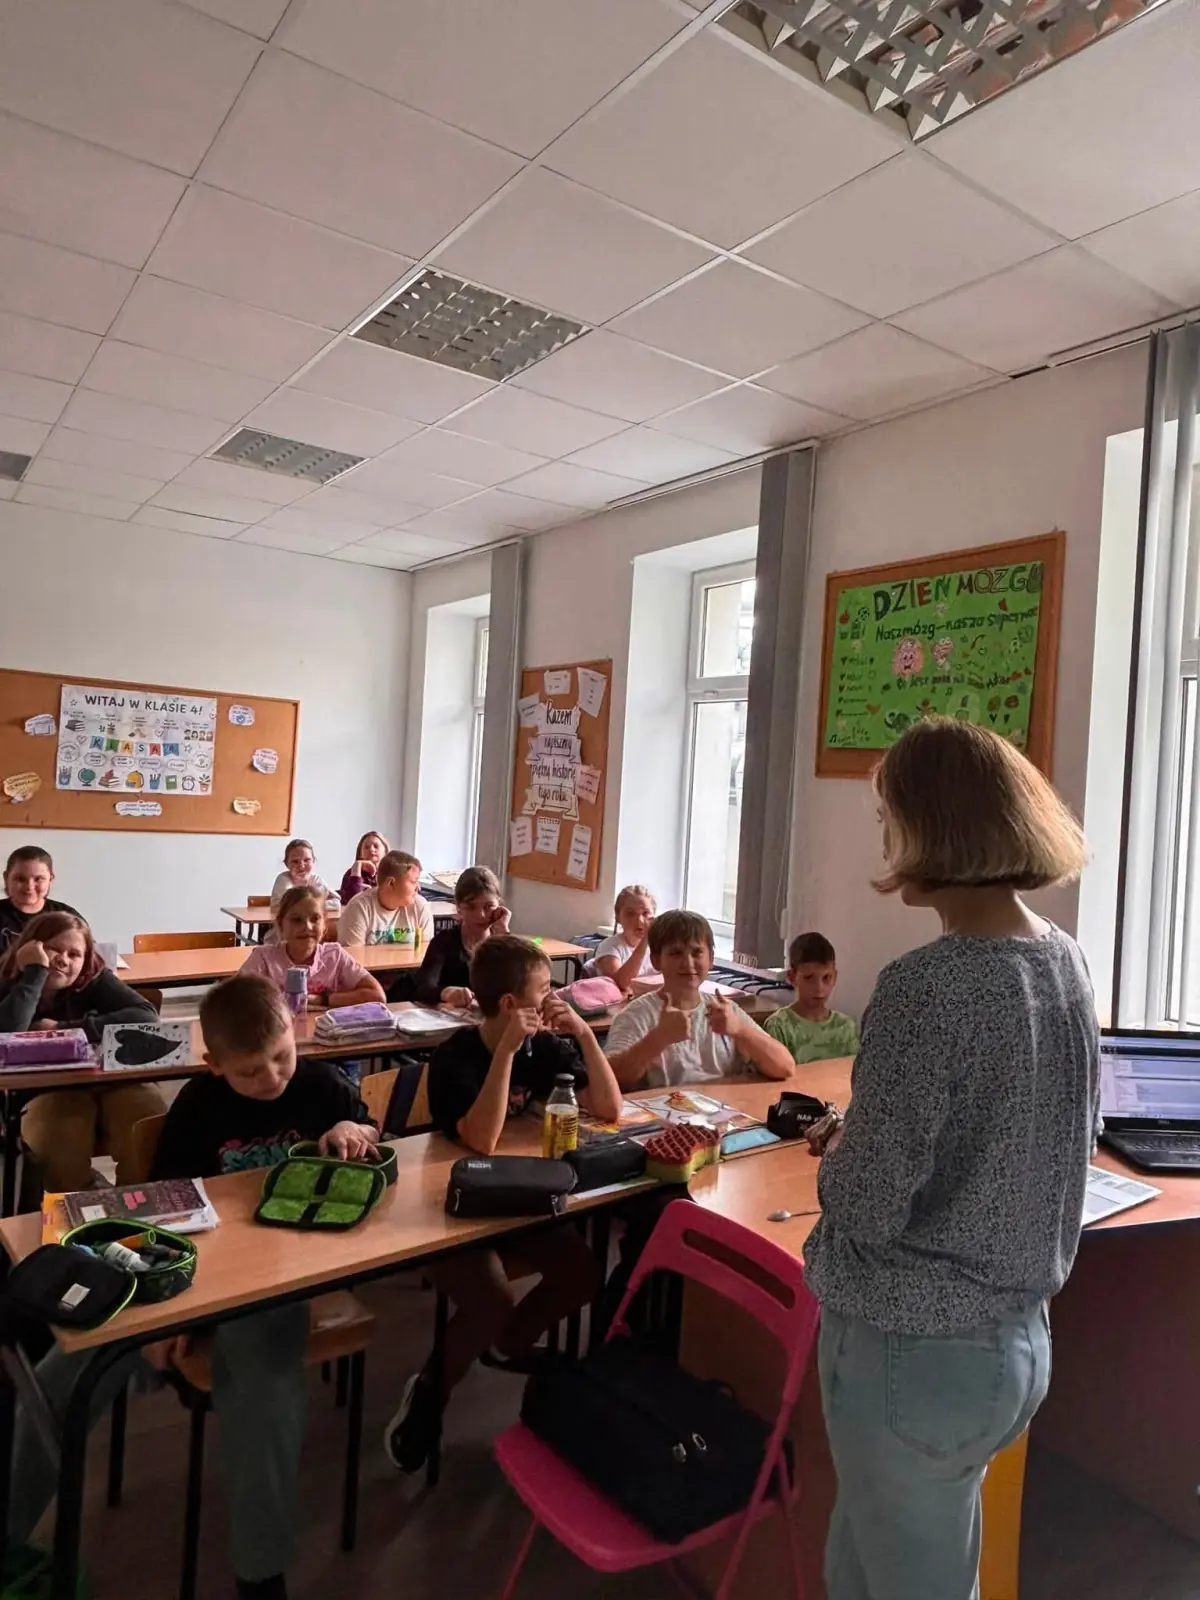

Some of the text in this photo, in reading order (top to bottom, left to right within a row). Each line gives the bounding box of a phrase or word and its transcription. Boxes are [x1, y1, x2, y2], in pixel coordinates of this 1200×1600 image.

[84, 695, 203, 715] WITAJ W KLASIE 4!
